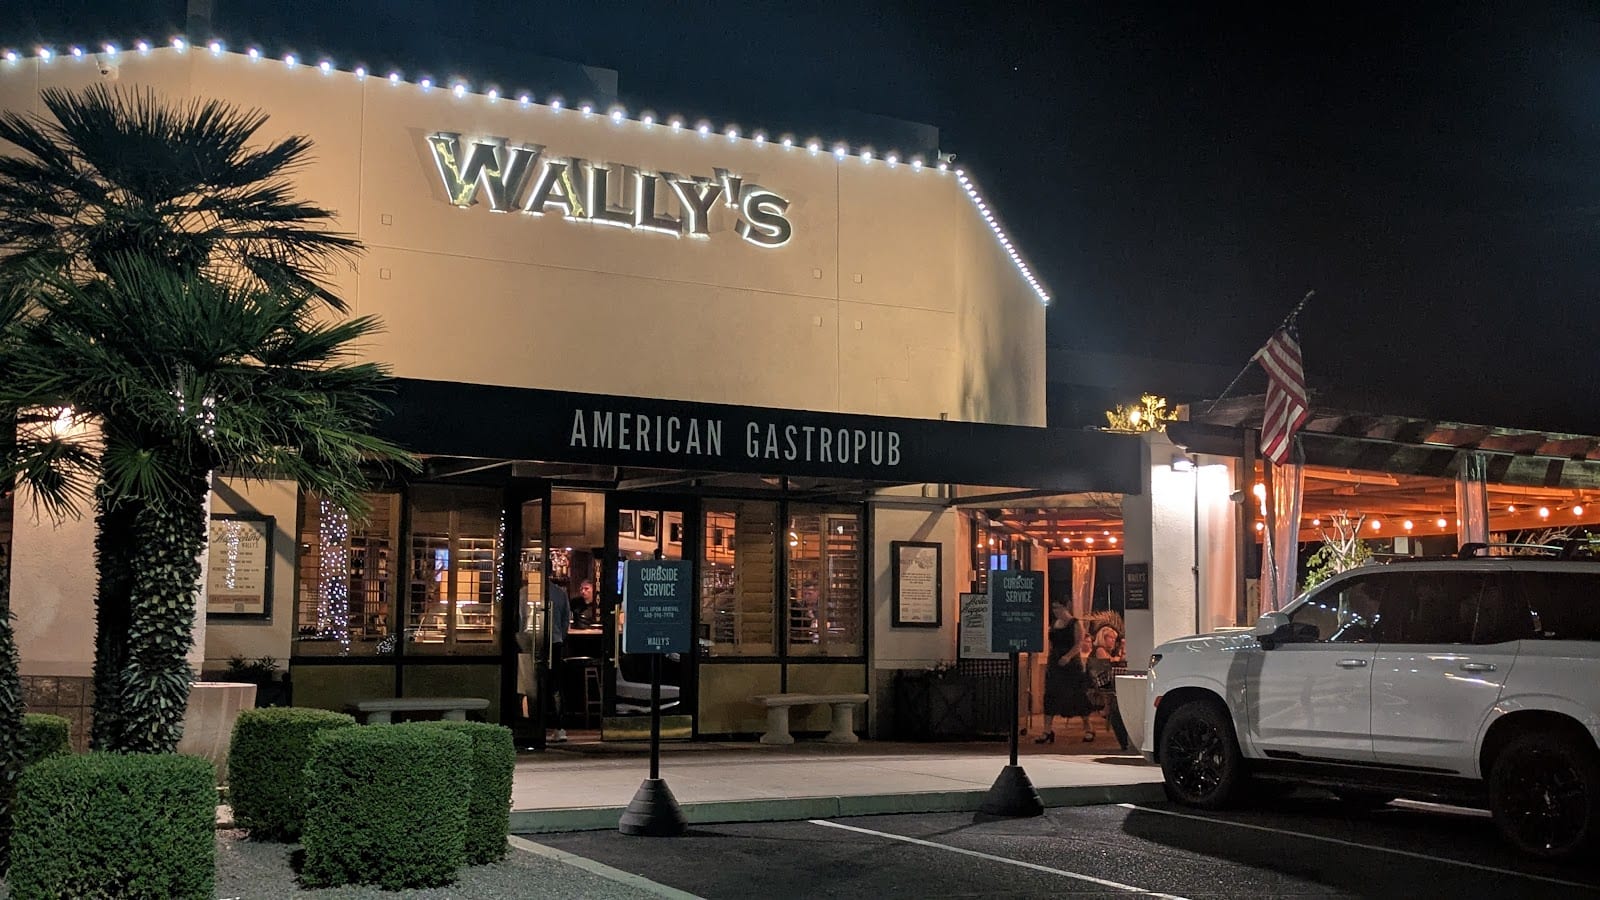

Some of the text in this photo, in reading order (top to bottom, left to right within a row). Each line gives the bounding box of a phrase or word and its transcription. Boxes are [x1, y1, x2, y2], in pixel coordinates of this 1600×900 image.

[426, 133, 792, 248] WALLY'S
[570, 409, 901, 466] AMERICAN GASTROPUB
[641, 567, 679, 582] CURBSIDE
[643, 583, 676, 597] SERVICE
[1003, 577, 1035, 590] CURBSIDE
[1005, 590, 1033, 603] SERVICE
[647, 637, 670, 646] WALLY'S
